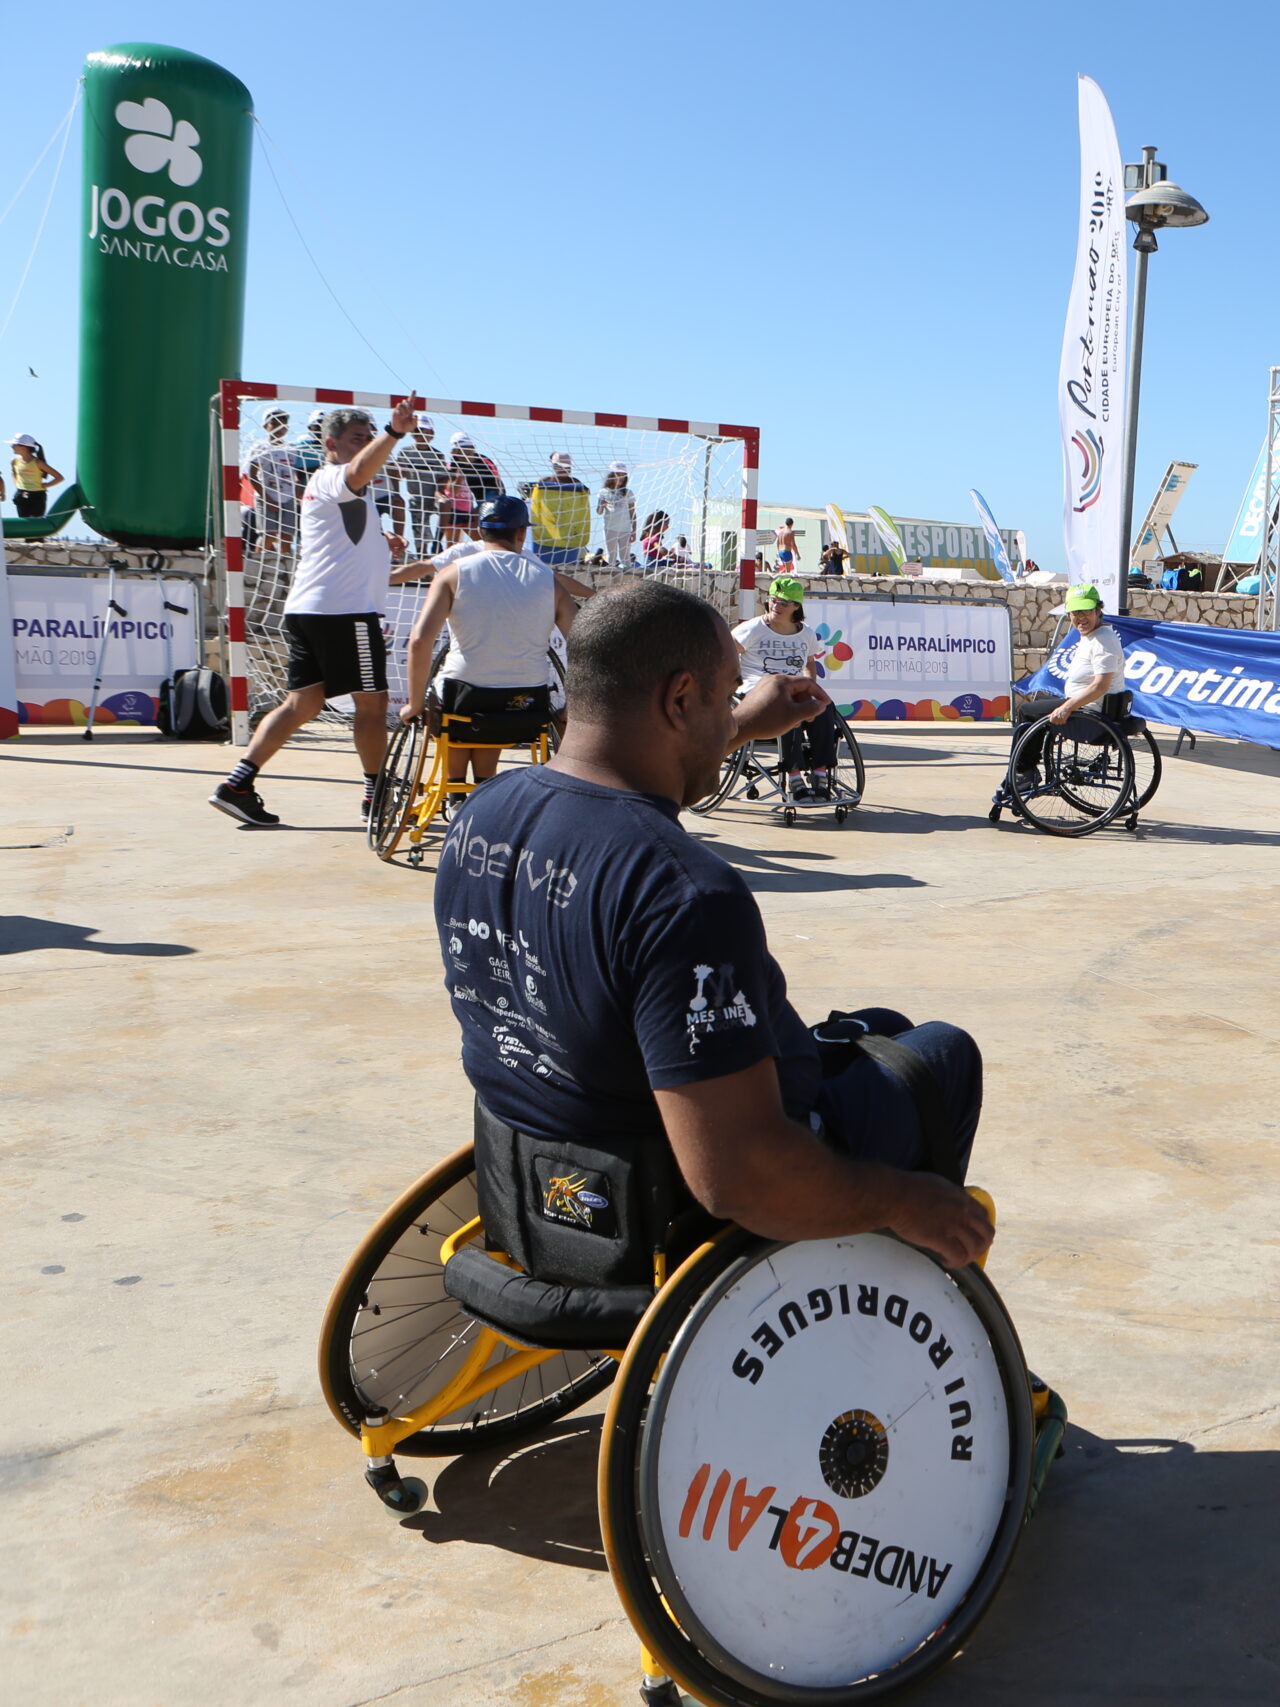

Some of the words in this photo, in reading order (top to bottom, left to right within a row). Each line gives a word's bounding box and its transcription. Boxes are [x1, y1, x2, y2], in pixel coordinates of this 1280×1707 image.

[89, 184, 231, 248] JOGOS
[13, 616, 174, 640] PARALÍMPICO
[868, 635, 894, 651] DIA
[897, 633, 996, 654] PARALÍMPICO
[58, 650, 97, 666] 2019
[868, 658, 923, 673] PORTIMÃO
[924, 660, 949, 674] 2019
[440, 814, 578, 909] Algarve
[731, 1283, 955, 1386] RODRIGUES
[943, 1376, 974, 1462] RUI
